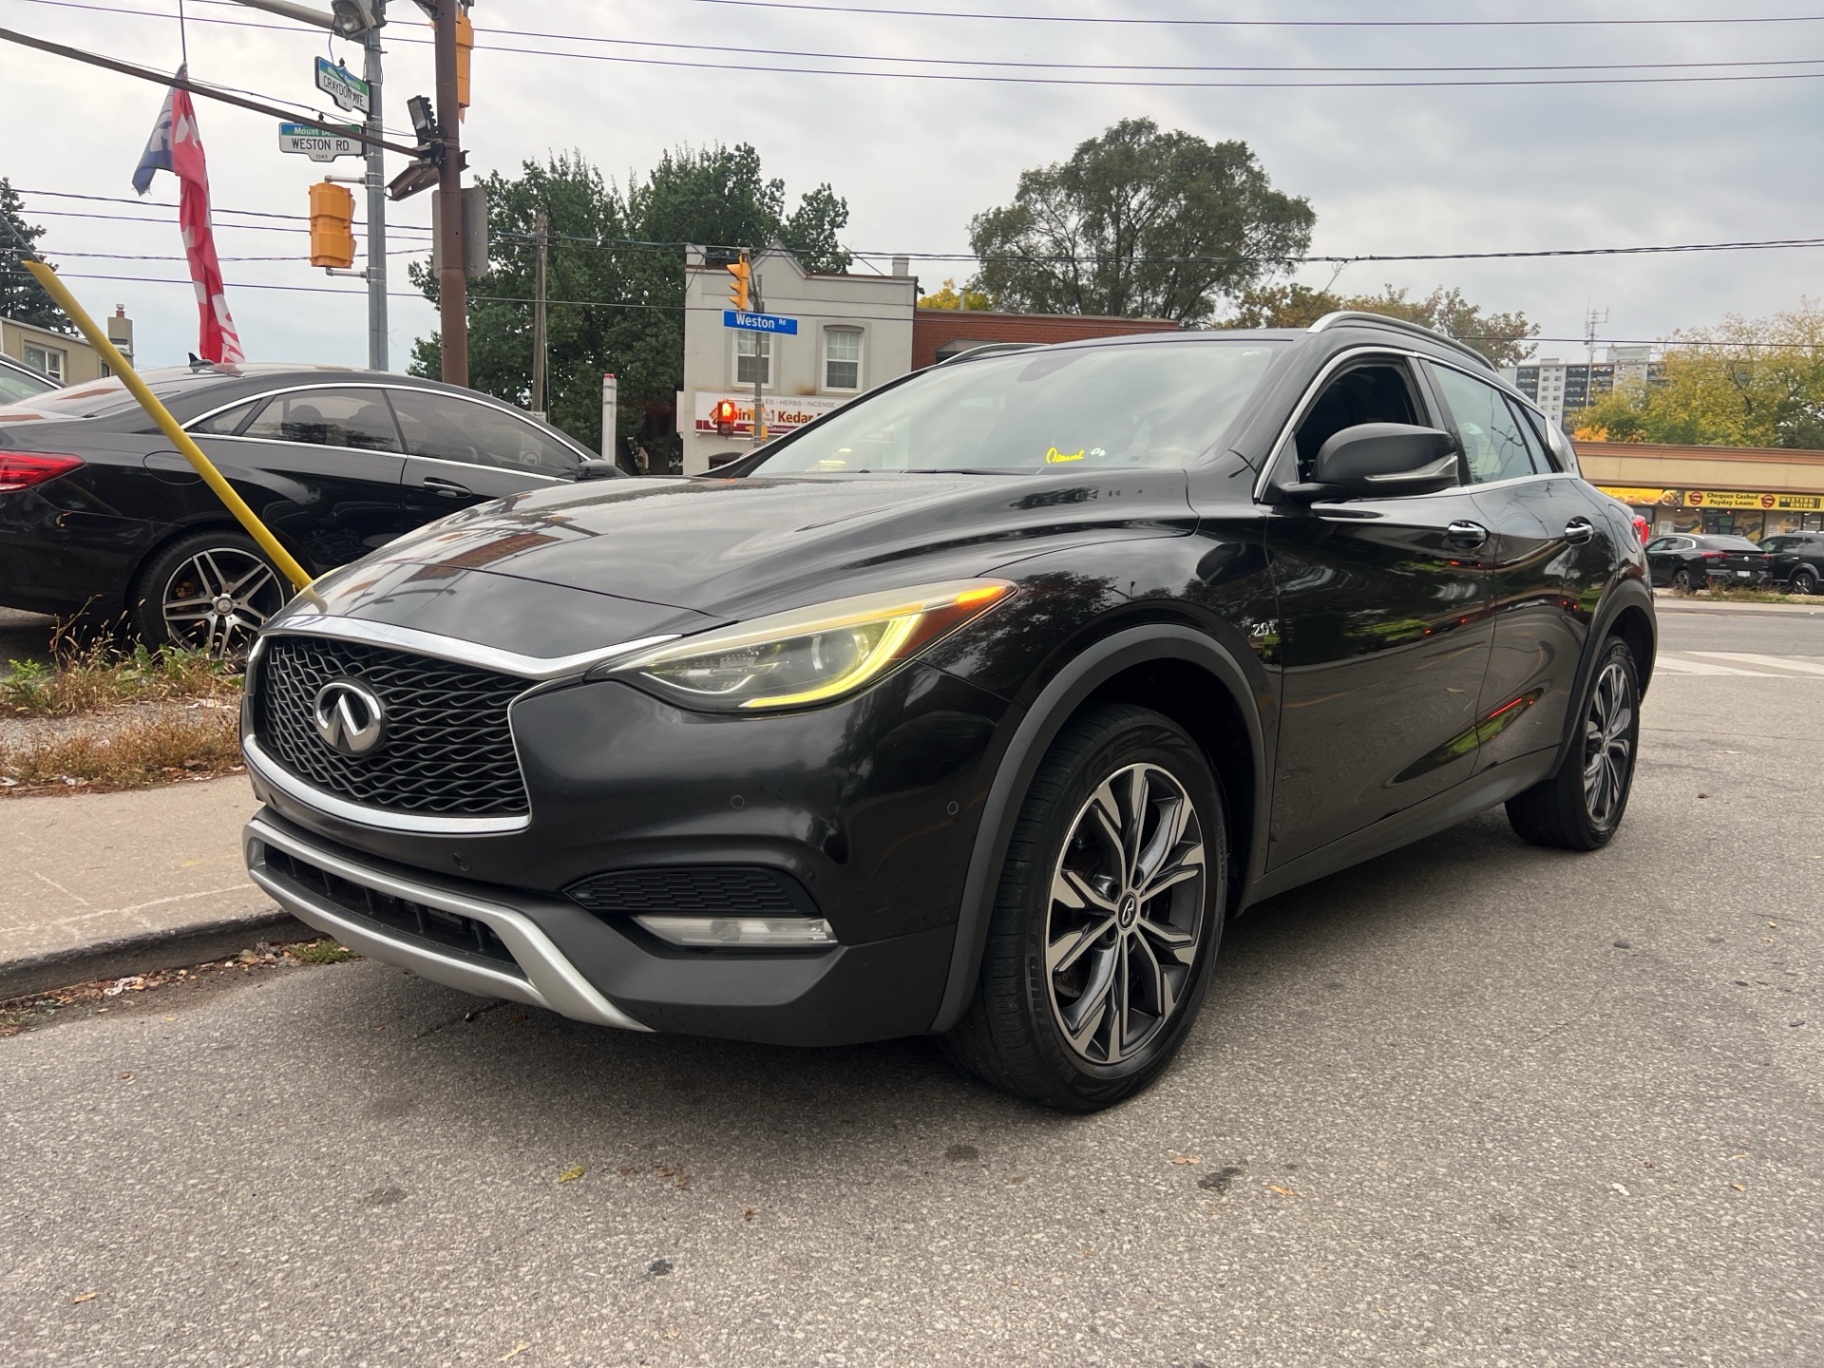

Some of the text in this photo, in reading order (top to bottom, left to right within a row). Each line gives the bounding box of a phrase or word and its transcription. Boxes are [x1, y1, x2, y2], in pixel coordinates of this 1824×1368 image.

[294, 126, 320, 136] Mount
[291, 138, 331, 151] WESTON
[736, 312, 787, 329] Weston Rd
[778, 410, 813, 424] Kedar
